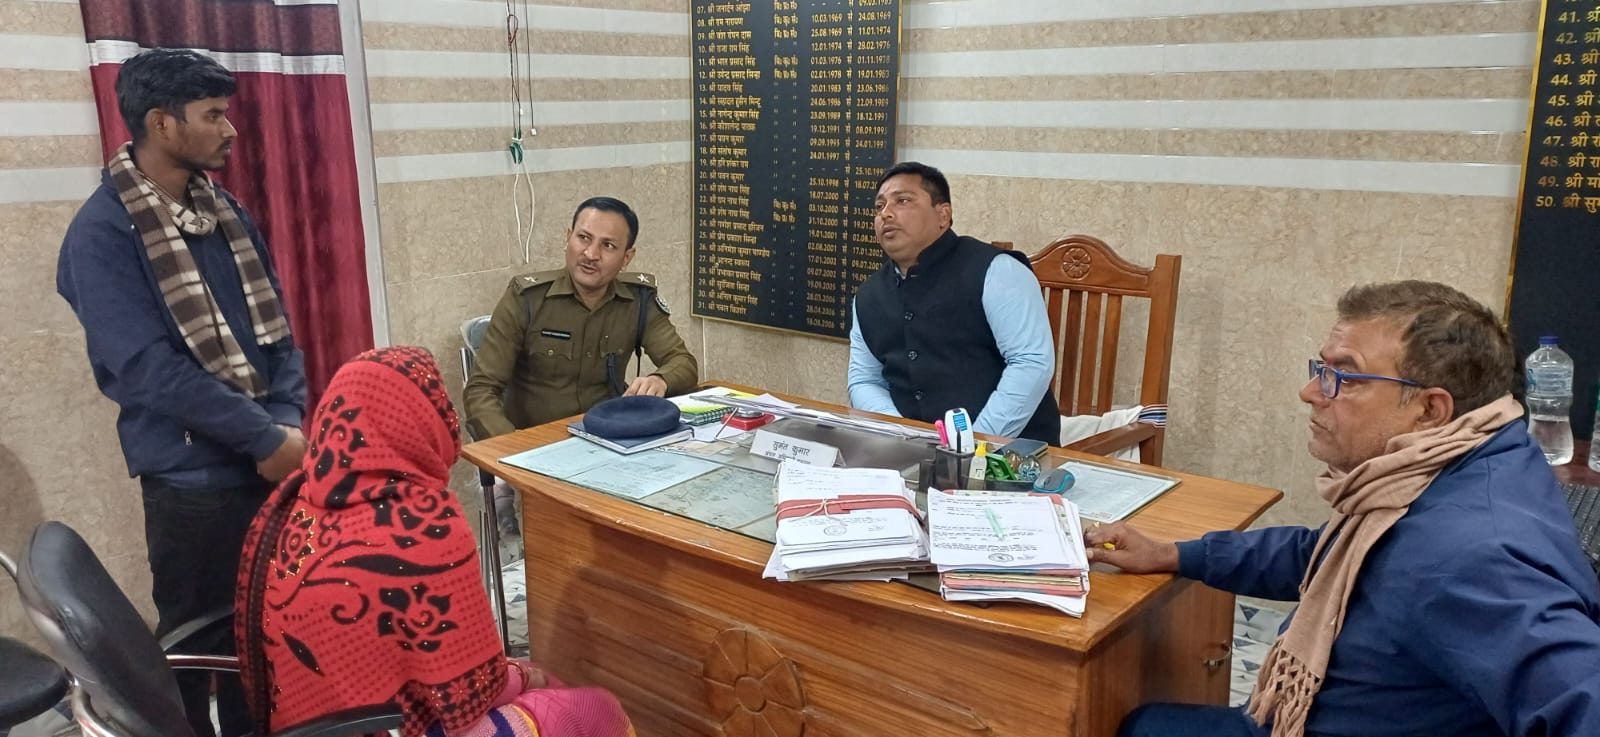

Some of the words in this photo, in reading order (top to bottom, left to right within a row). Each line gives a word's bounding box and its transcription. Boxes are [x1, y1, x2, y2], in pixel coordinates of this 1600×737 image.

[812, 13, 842, 23] 10.03.1969
[859, 11, 891, 22] 24.08.1969
[1558, 11, 1580, 23] 41.
[812, 27, 842, 37] 25.08.1969
[859, 25, 891, 36] 11.01.1974
[1556, 32, 1578, 44] 42.
[1584, 28, 1600, 43] श्री
[738, 42, 750, 54] सिंह
[812, 41, 842, 51] 12.01.1974
[744, 55, 756, 67] सिंह
[811, 55, 842, 65] 01.03.1976
[1553, 53, 1575, 65] 43.
[1581, 49, 1600, 64] श्री
[811, 69, 842, 79] 02.01.1978
[1551, 74, 1573, 85] 44.
[1578, 69, 1597, 85] श्री
[1548, 95, 1570, 106] 45.
[1575, 90, 1595, 106] श्री
[1545, 115, 1567, 127] 46.
[1573, 111, 1592, 127] श्री
[1543, 136, 1565, 147] 47.
[1570, 132, 1589, 147] श्री
[1540, 155, 1560, 167] 48.
[1568, 152, 1587, 168] श्री
[1538, 176, 1559, 187] 49.
[1565, 173, 1584, 188] श्री
[1535, 196, 1556, 207] 50.
[1562, 193, 1581, 208] श्री
[708, 289, 716, 299] श्री
[708, 300, 716, 311] श्री
[791, 445, 810, 457] कुमार
